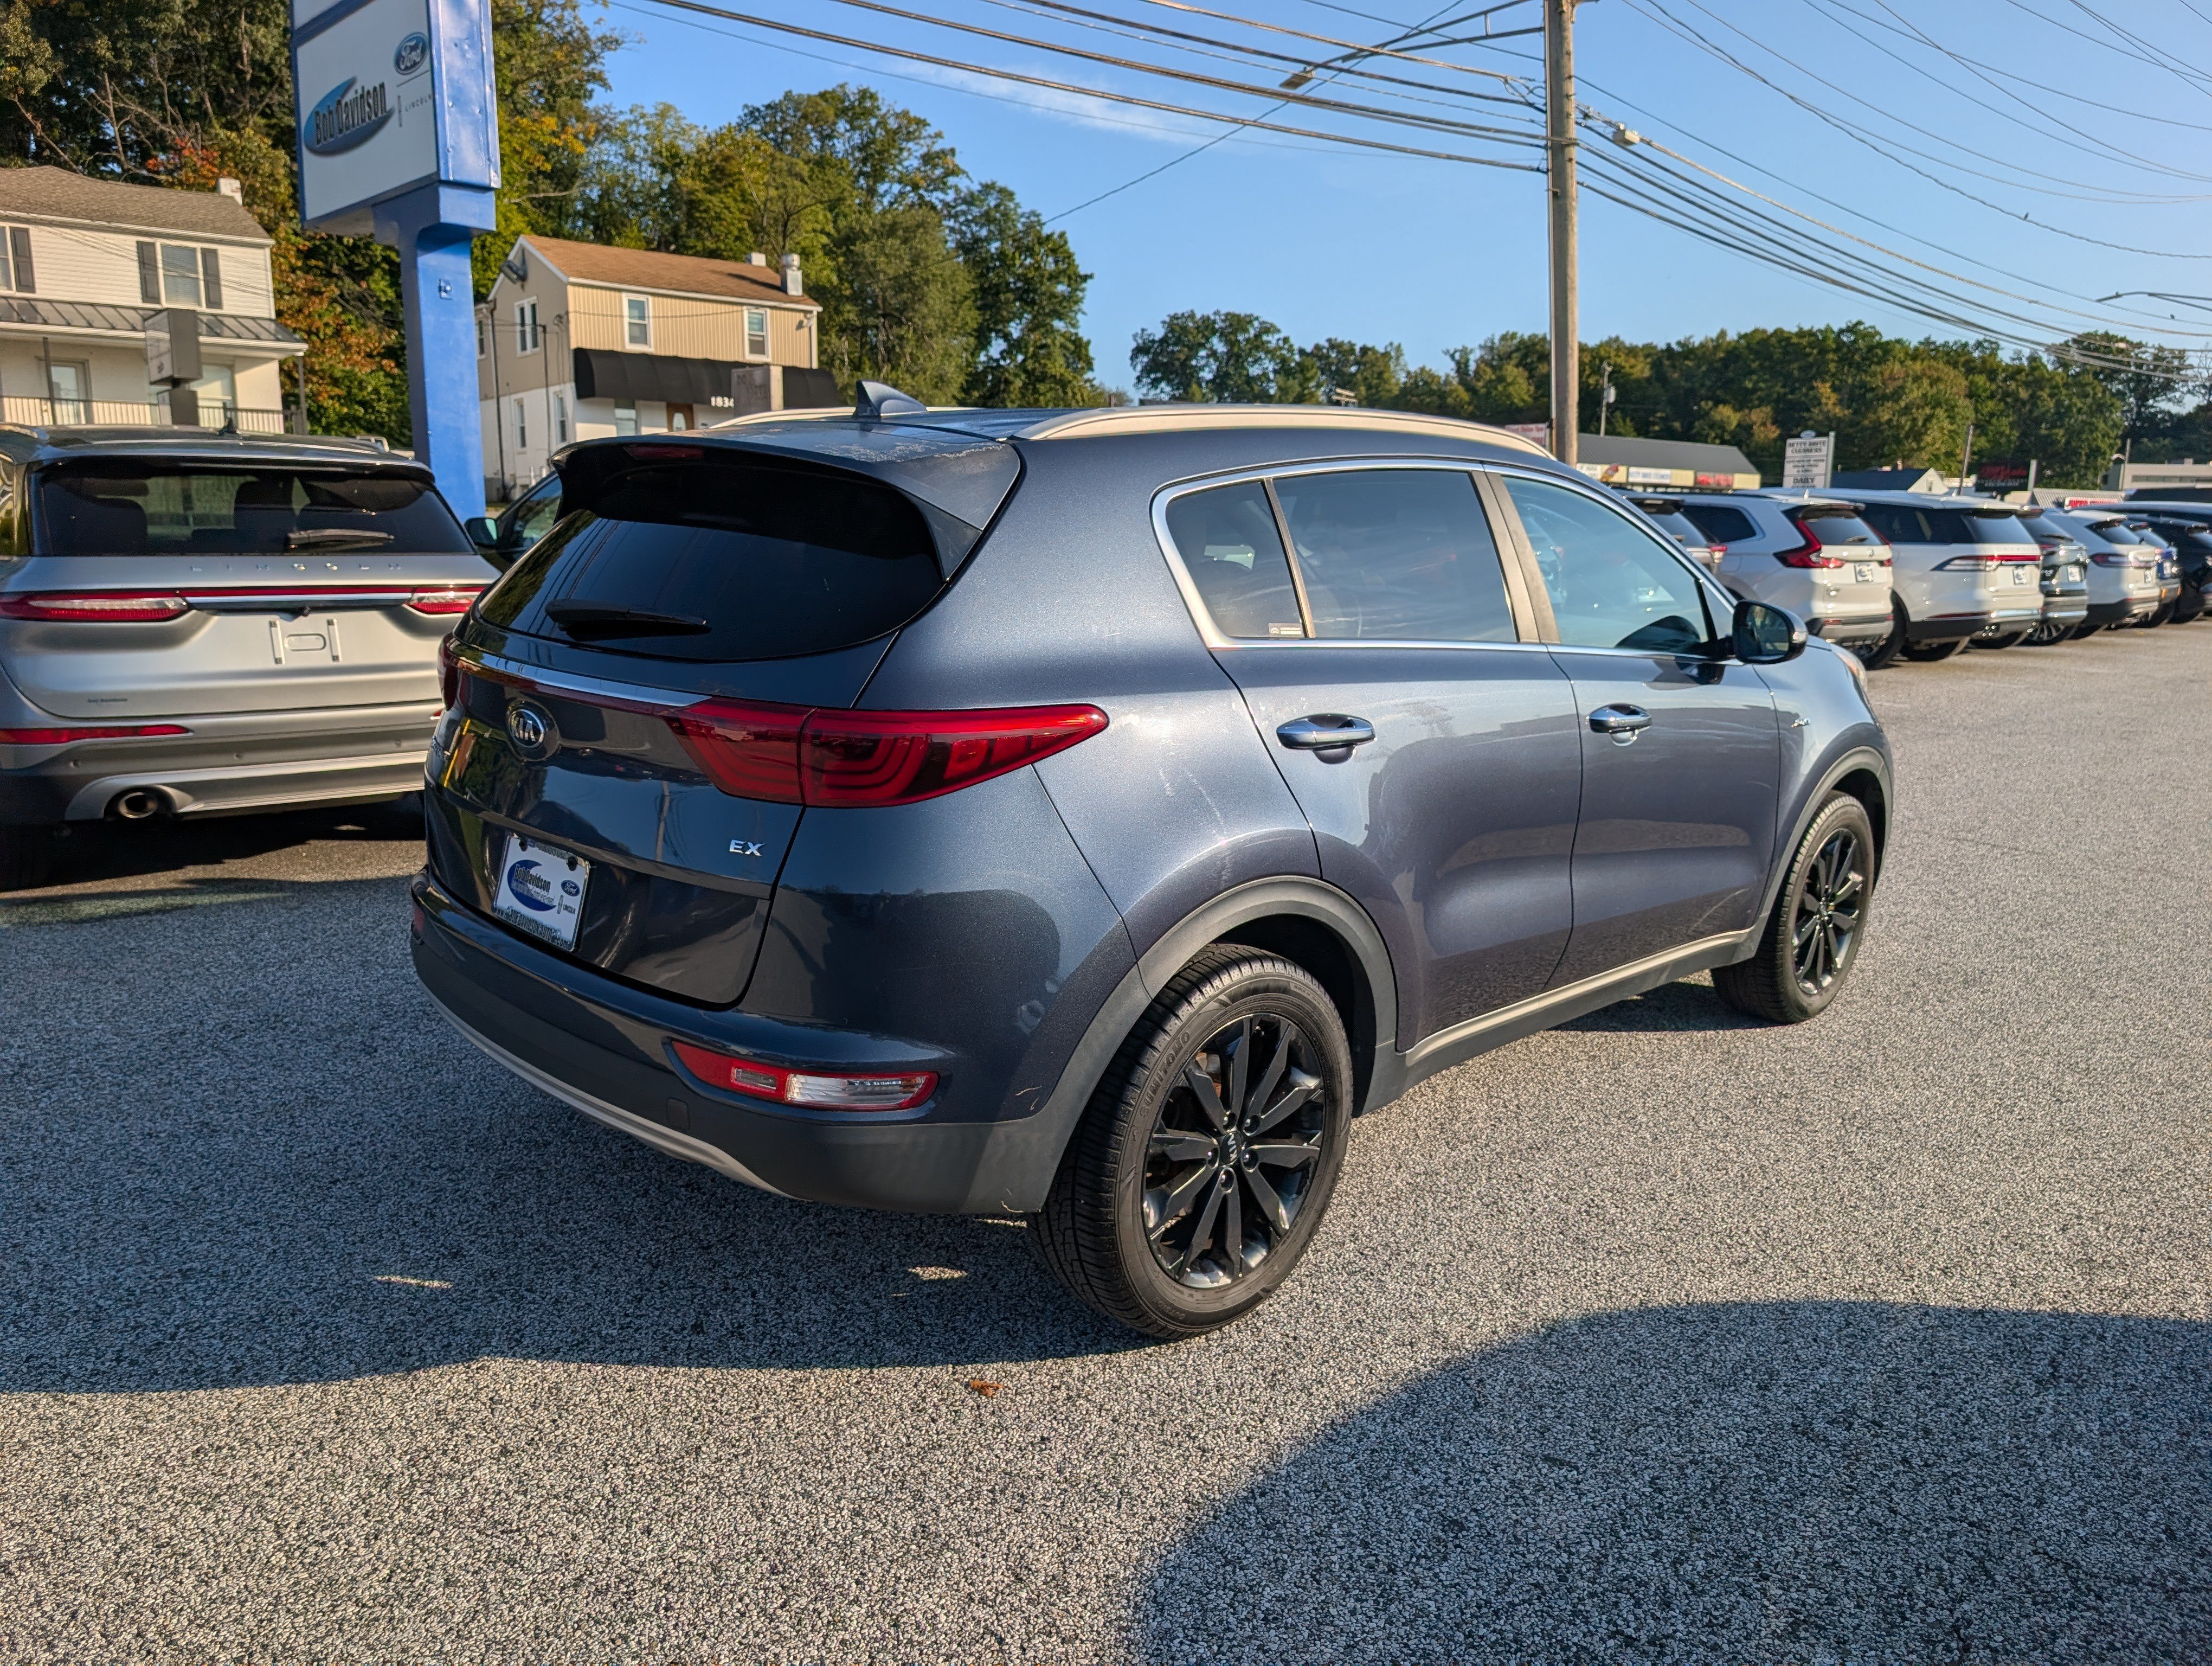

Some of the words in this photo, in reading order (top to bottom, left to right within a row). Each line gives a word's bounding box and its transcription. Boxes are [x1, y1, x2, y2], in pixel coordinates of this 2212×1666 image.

[400, 40, 422, 70] Ford
[314, 105, 334, 145] Bob
[336, 82, 387, 134] Davidson
[511, 713, 536, 742] KIA
[729, 839, 766, 856] EX
[514, 864, 526, 881] Bob
[525, 868, 551, 893] Davidson
[564, 880, 577, 894] Ford
[562, 902, 576, 915] LINCOLN
[1140, 1031, 1191, 1118] SUMITOMO
[1227, 1133, 1238, 1162] KIA
